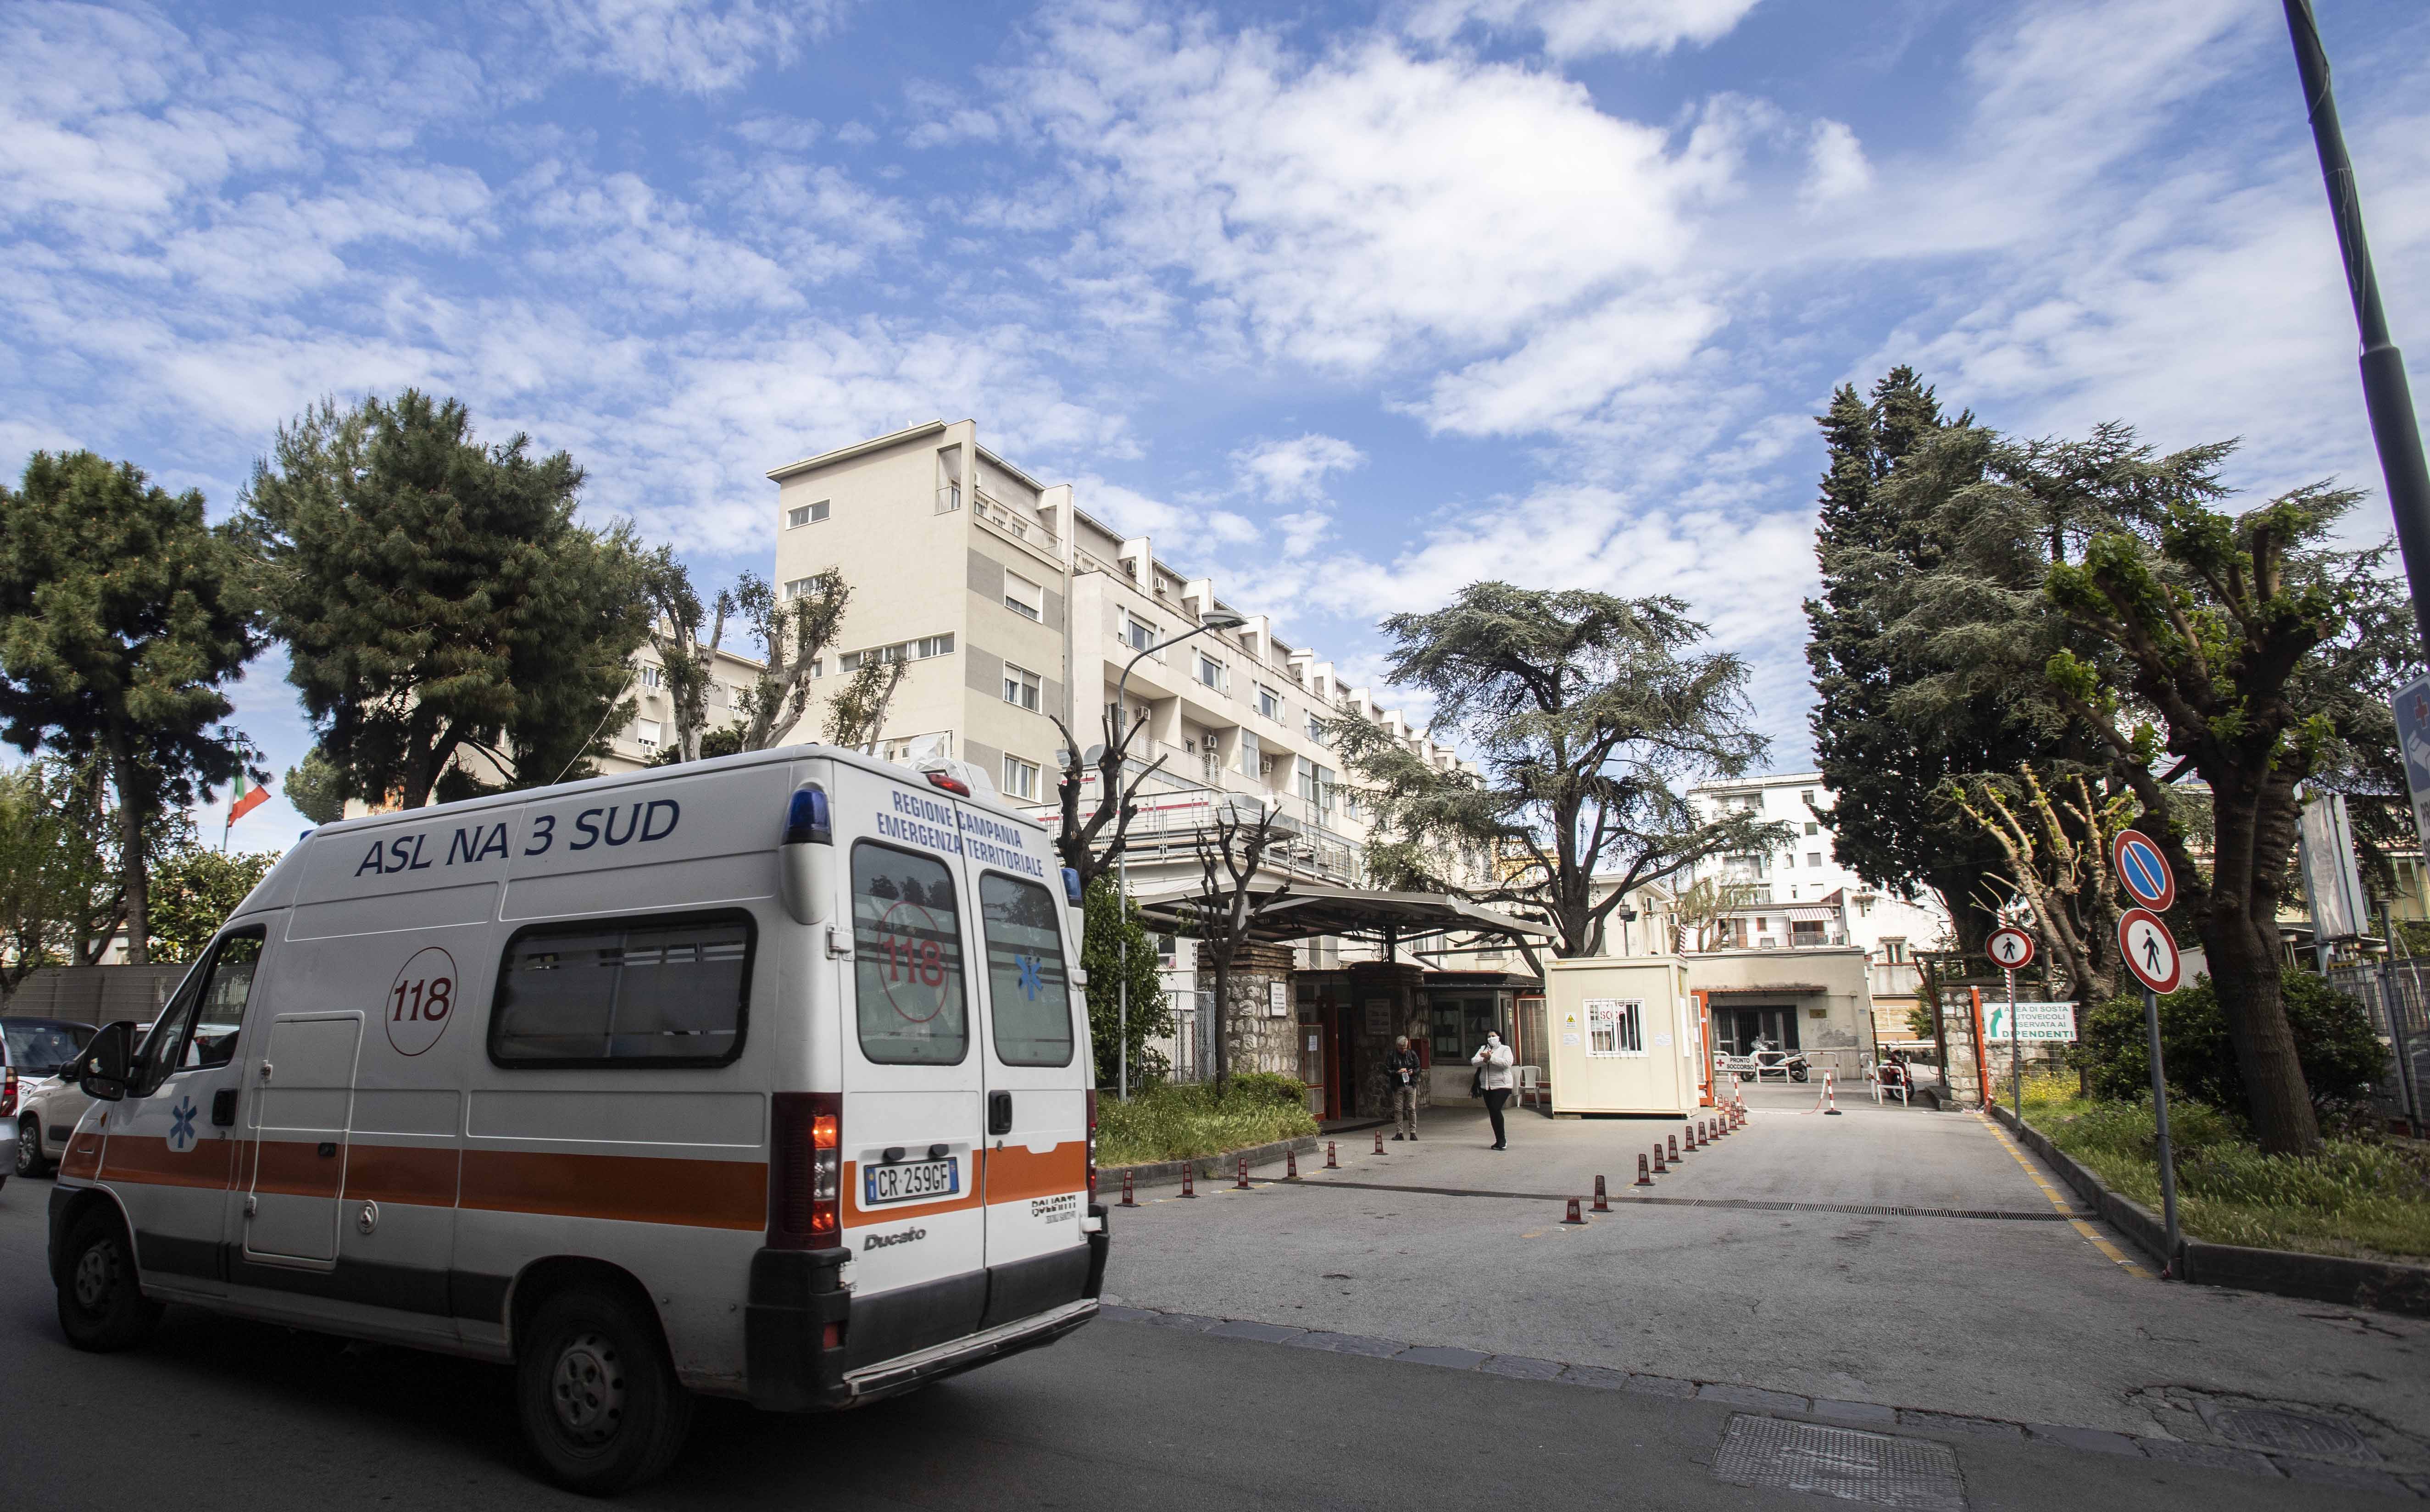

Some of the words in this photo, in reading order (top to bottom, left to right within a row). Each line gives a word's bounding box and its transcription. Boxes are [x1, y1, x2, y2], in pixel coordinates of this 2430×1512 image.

[354, 834, 433, 877] ASL
[445, 823, 509, 866] NA
[524, 815, 556, 856] 3
[569, 799, 680, 851] SUD
[876, 812, 963, 856] EMERGENZA
[966, 838, 1044, 878] TERRITORIALE
[892, 790, 953, 827] REGIONE
[956, 810, 1023, 849] CAMPANIA
[884, 934, 944, 987] 118
[392, 977, 451, 1021] 118
[879, 1169, 898, 1197] CR
[904, 1163, 947, 1194] 259GF
[863, 1226, 926, 1251] Ducato
